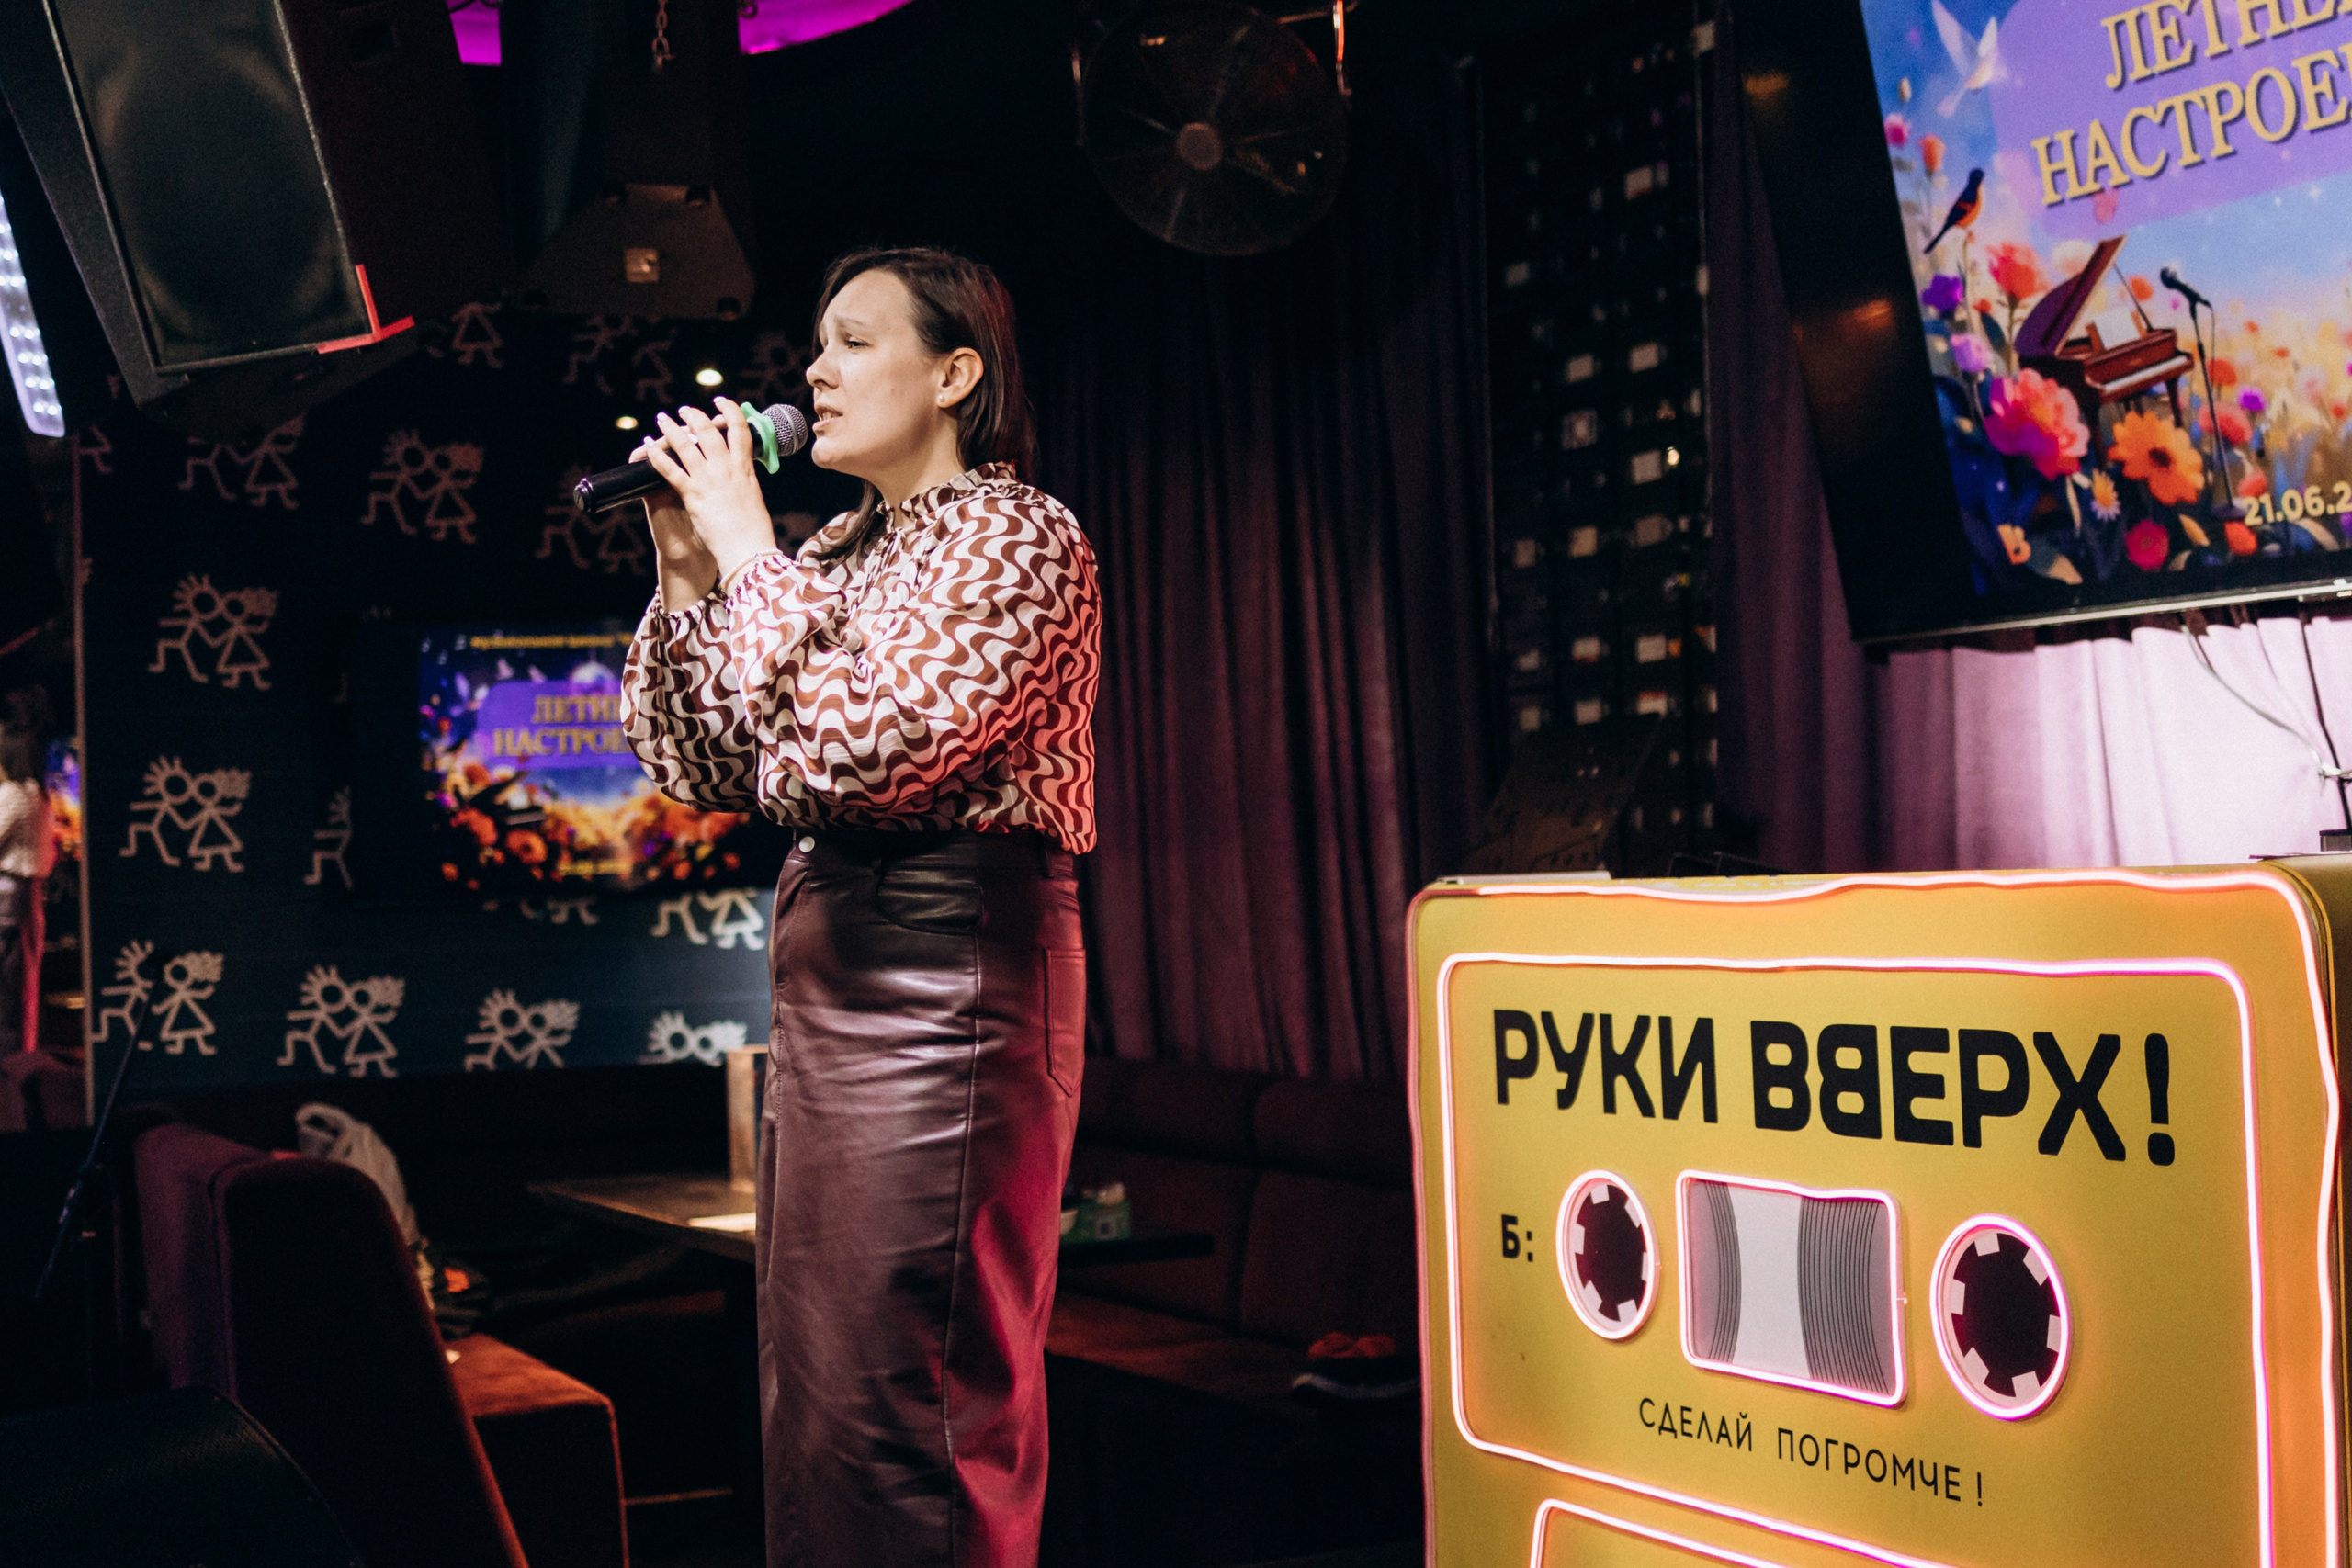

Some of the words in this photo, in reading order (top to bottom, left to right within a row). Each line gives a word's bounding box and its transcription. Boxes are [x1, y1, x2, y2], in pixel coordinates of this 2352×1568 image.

[2030, 42, 2352, 206] НАСТРОЕ
[1493, 1009, 1718, 1123] РУКИ
[1501, 1214, 1533, 1263] Б:
[1639, 1397, 1752, 1452] СДЕЛАЙ
